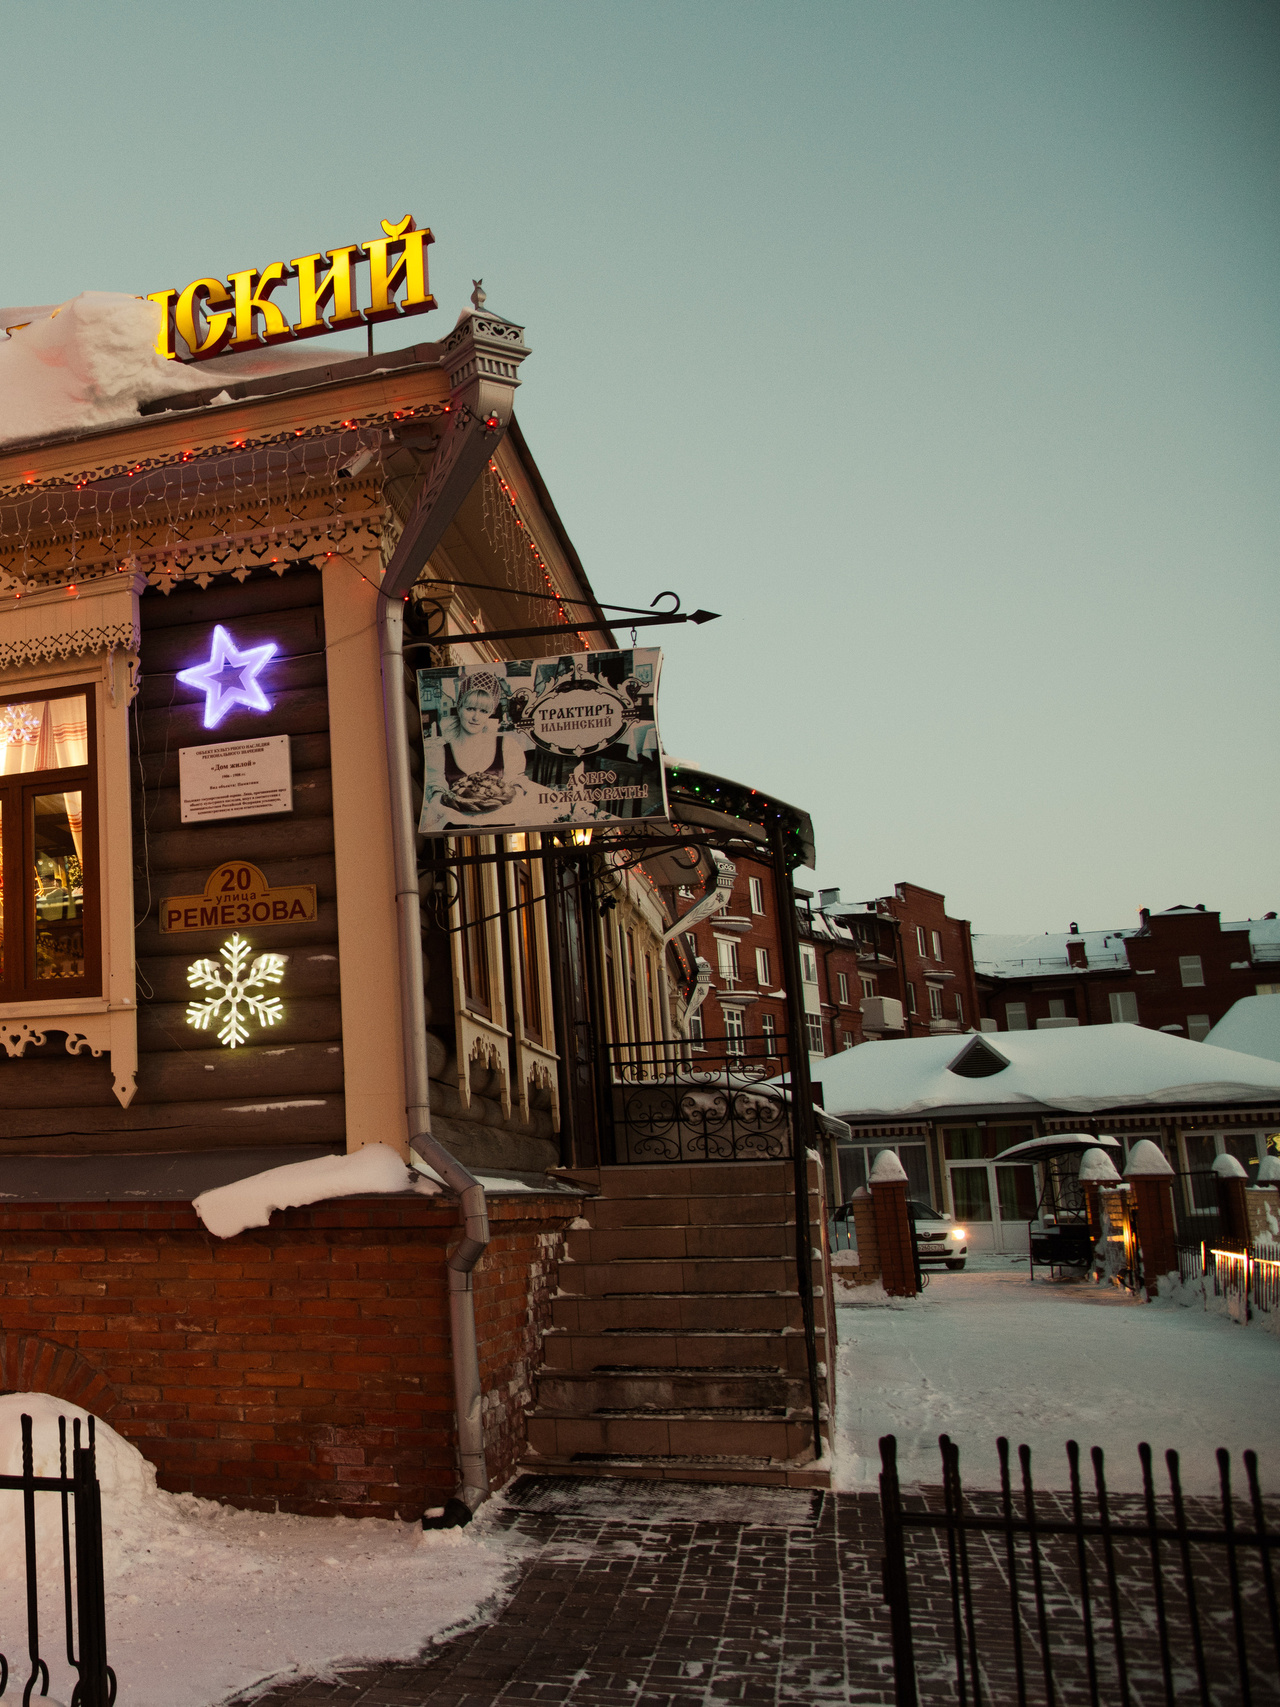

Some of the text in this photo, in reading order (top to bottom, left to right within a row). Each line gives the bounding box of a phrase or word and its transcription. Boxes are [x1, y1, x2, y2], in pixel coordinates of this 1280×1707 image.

[539, 704, 614, 721] ТРАКТИРЪ
[540, 716, 612, 733] ИЛЬИНСКИЙ
[567, 769, 616, 788] ДОБРО
[538, 784, 649, 805] ПОЖАЛОВАТЬ!
[220, 867, 251, 892] 20
[216, 891, 257, 905] улица
[168, 898, 308, 929] РЕМЕЗОВА
